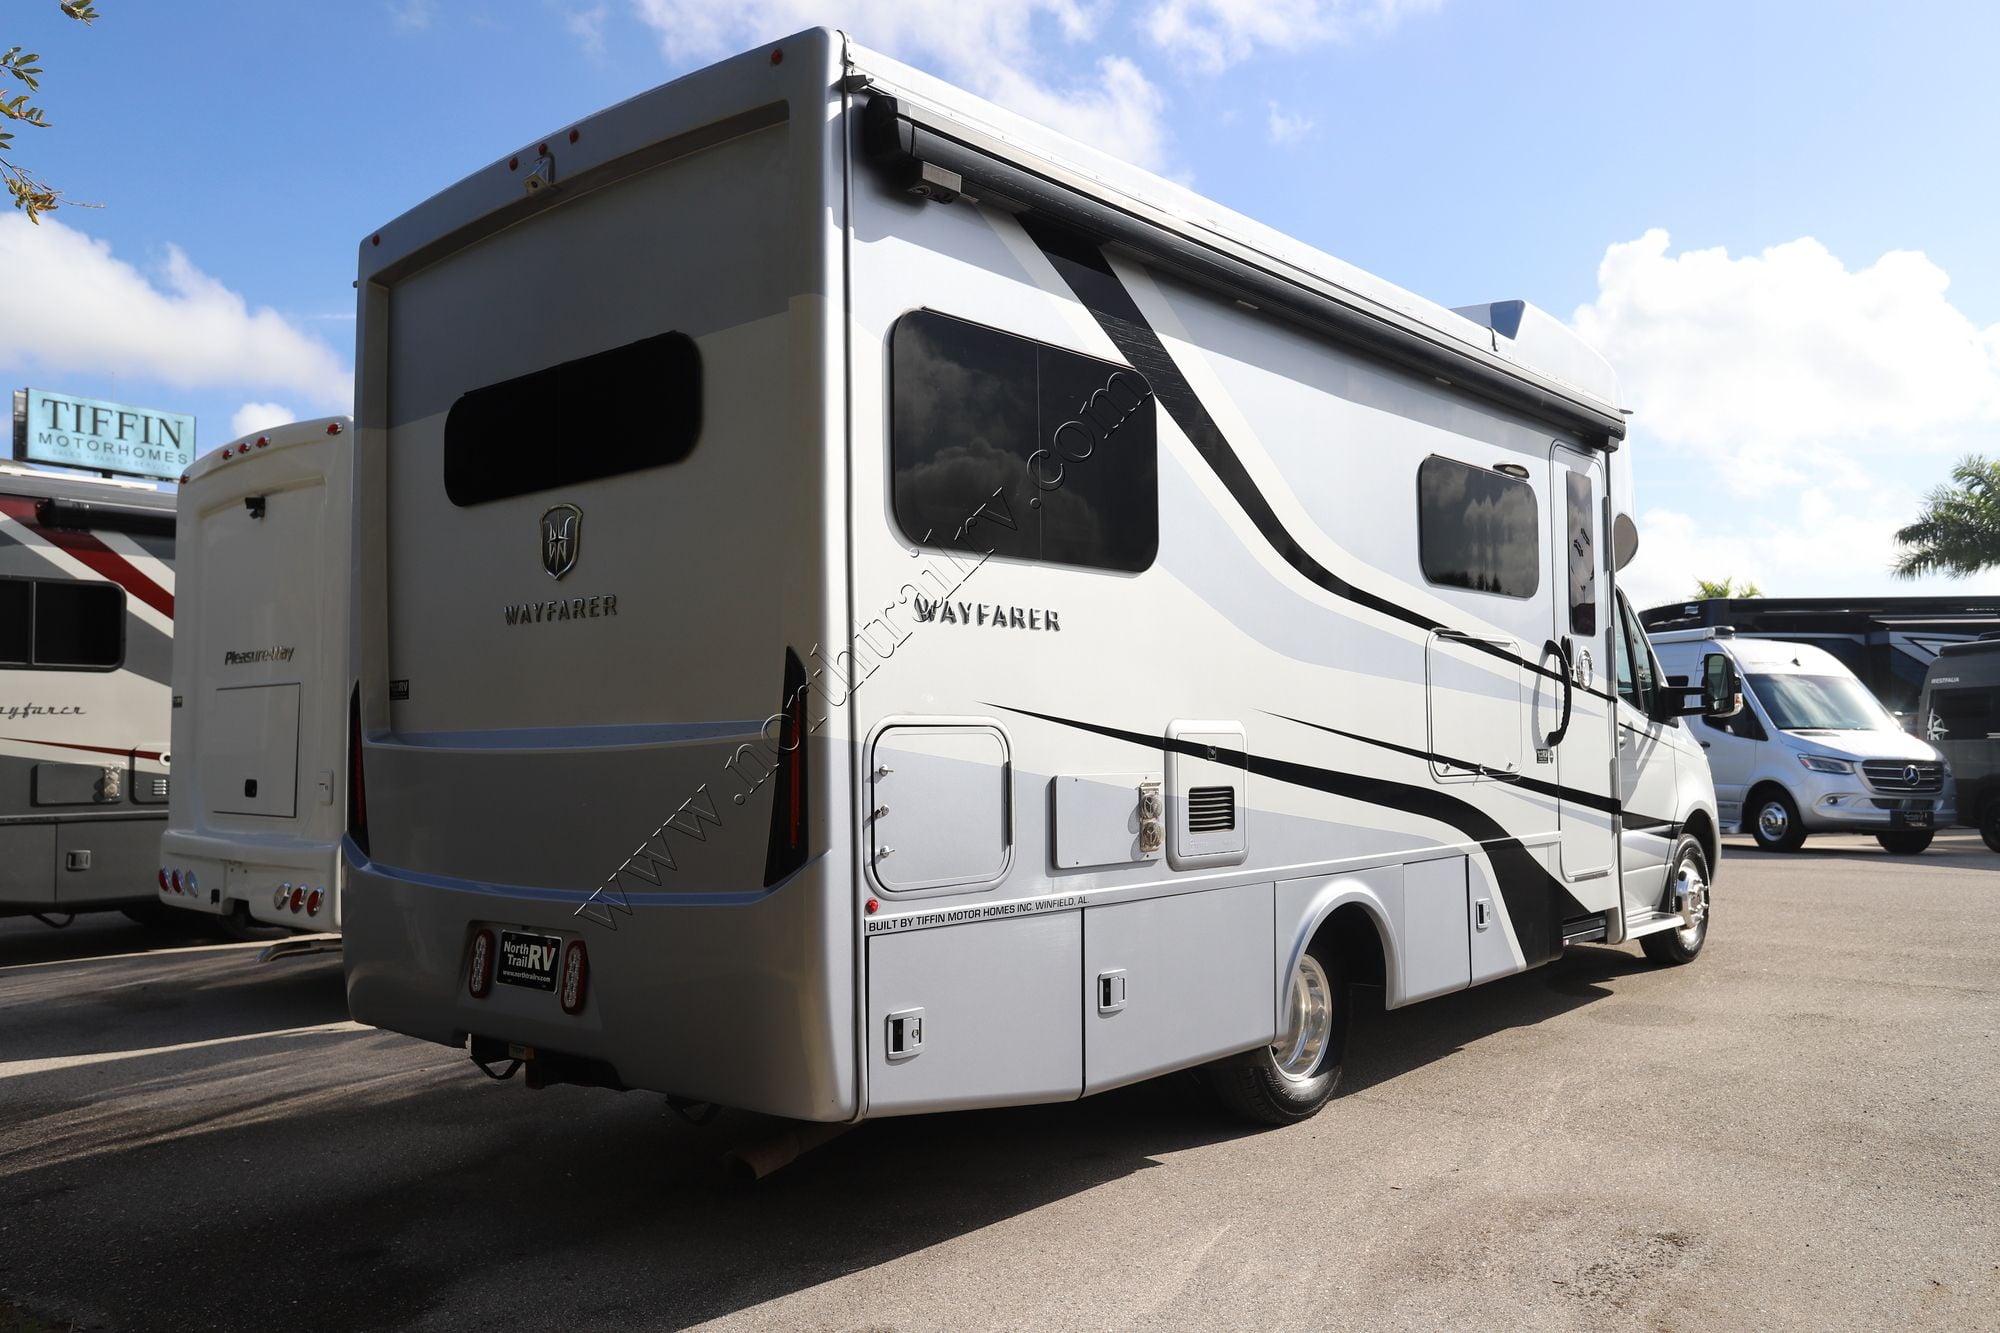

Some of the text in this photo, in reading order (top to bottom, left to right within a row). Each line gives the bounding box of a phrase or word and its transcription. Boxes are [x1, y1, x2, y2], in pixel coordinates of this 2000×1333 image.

[41, 398, 184, 449] TIFFIN
[38, 432, 188, 465] MOTORHOMES
[504, 594, 618, 626] WAYFARER
[914, 598, 1061, 632] WAYFARER
[224, 646, 295, 666] Pleasure-Way
[868, 919, 898, 932] BUILT
[900, 917, 914, 928] BY
[916, 914, 945, 926] TIFFIN
[947, 909, 981, 922] MOTOR
[983, 904, 1016, 917] HOMES
[1017, 902, 1033, 912] INC.
[1035, 897, 1076, 911] WINFIELD,
[504, 941, 528, 955] North
[507, 944, 556, 971] Trail RV
